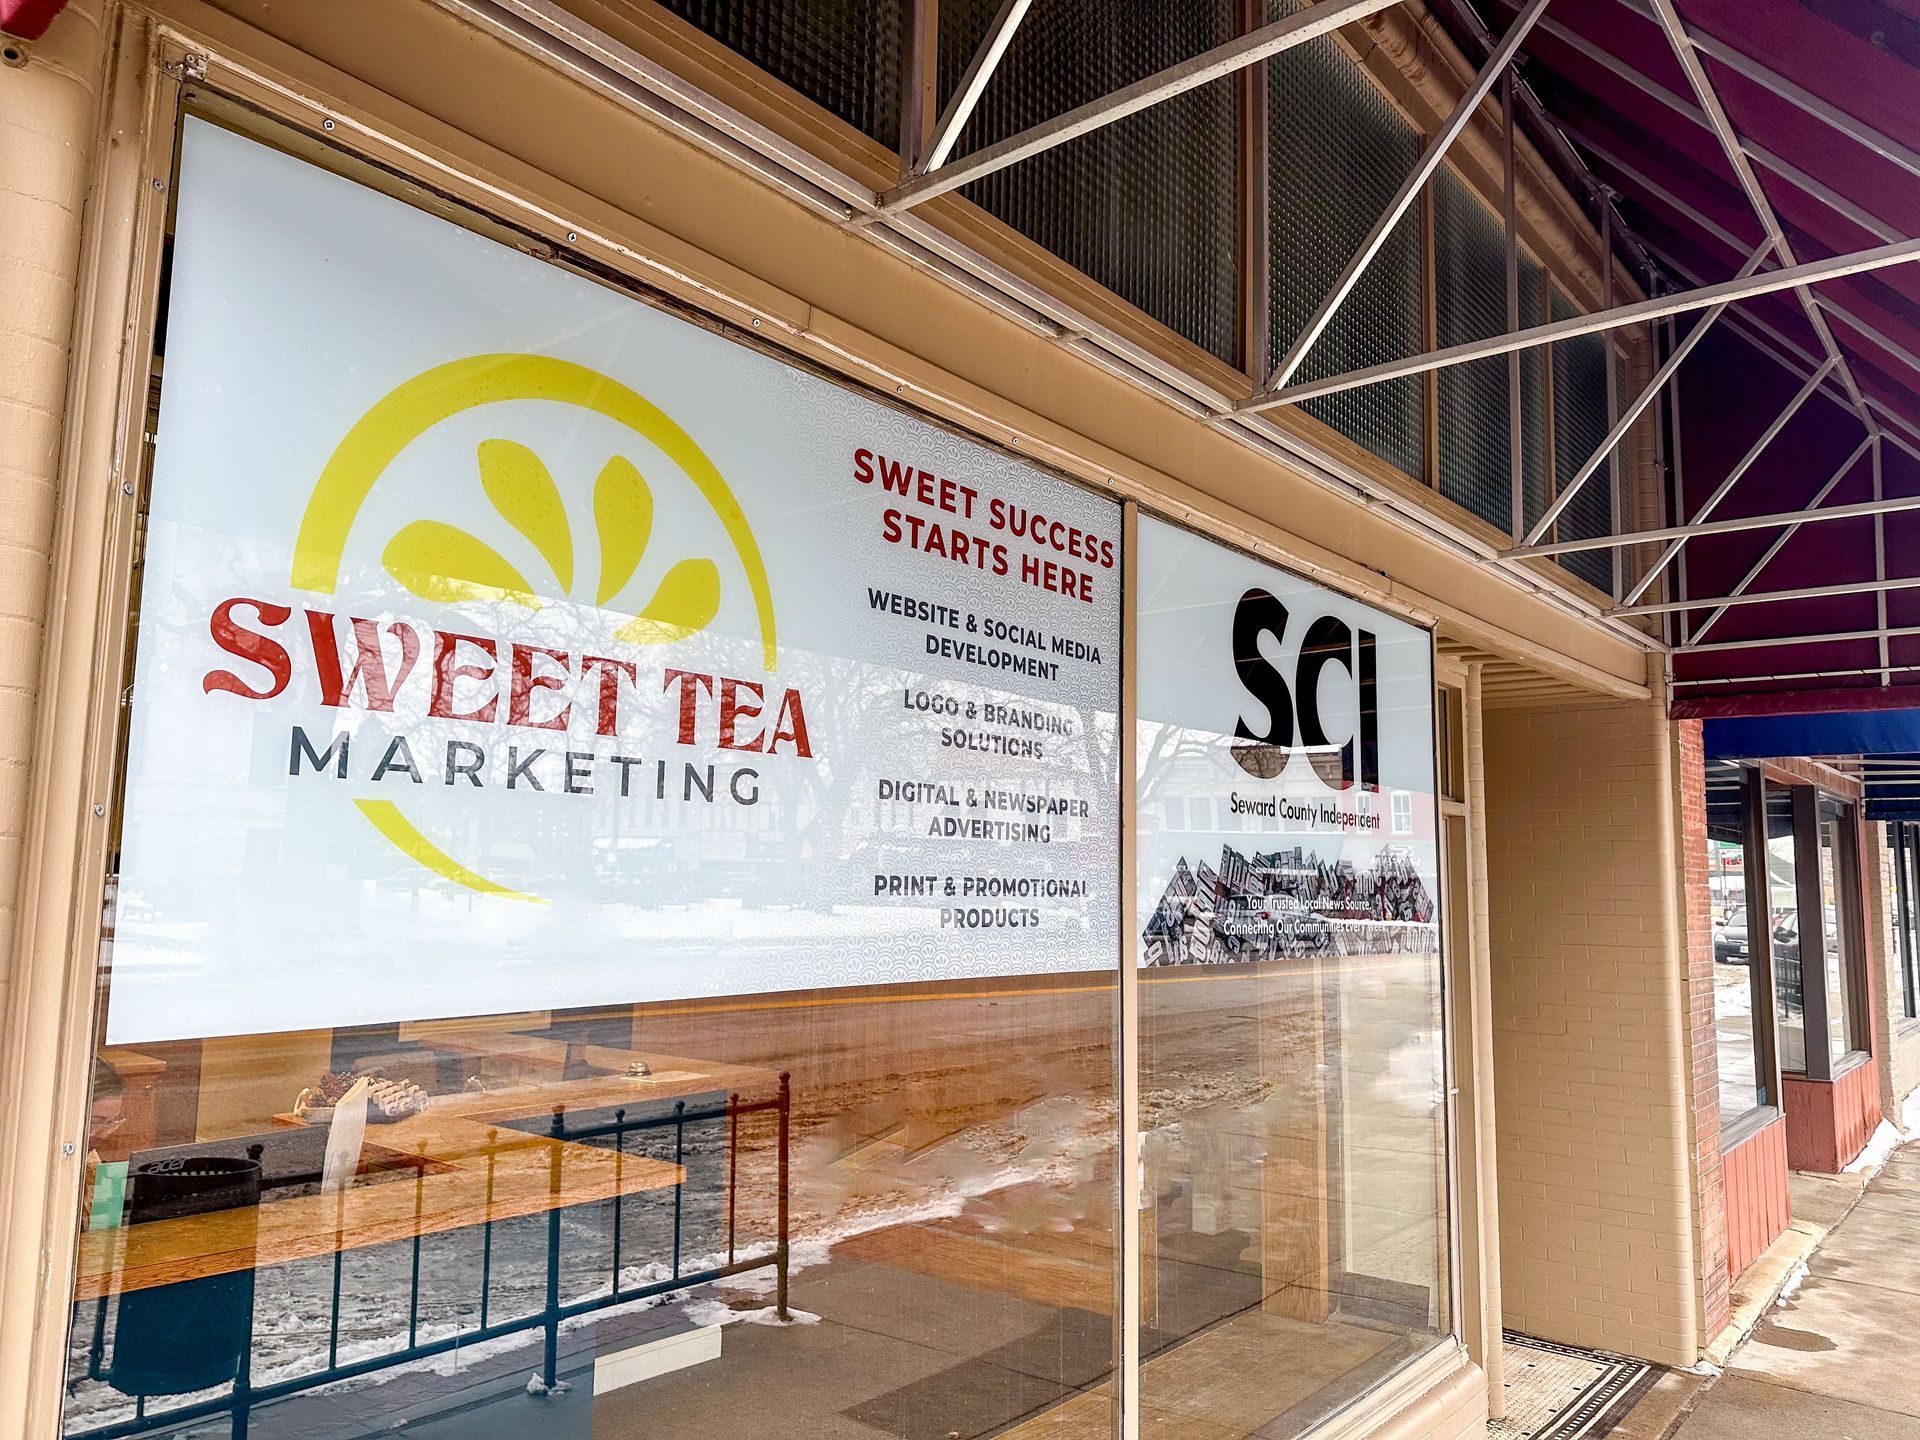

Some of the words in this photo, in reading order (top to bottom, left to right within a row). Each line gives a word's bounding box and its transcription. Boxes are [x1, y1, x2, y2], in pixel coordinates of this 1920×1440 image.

[853, 448, 978, 519] SWEET
[989, 498, 1114, 569] SUCCESS
[882, 508, 1009, 576] STARTS
[1021, 553, 1094, 604] HERE
[867, 587, 959, 629] WEBSITE
[965, 613, 978, 633] &
[984, 618, 1047, 651] SOCIAL
[1051, 635, 1101, 665] MEDIA
[202, 596, 638, 738] SWEET
[663, 667, 813, 758] TEA
[925, 634, 1059, 682] DEVELOPMENT
[903, 688, 959, 716] LOGO
[965, 700, 978, 720] &
[984, 703, 1073, 736] BRANDING
[941, 726, 1043, 760] SOLUTIONS
[288, 725, 760, 806] MARKETING
[878, 778, 960, 806] DIGITAL
[965, 788, 978, 808] &
[984, 789, 1089, 818] NEWSPAPER
[1230, 791, 1276, 818] Seward
[1279, 797, 1318, 829] County
[1320, 803, 1380, 830] Independent
[928, 816, 1051, 843] ADVERTISING
[874, 875, 937, 896] PRINT
[943, 876, 956, 897] &
[963, 876, 1088, 898] PROMOTIONAL
[1246, 894, 1266, 911] Your
[1268, 894, 1299, 911] Trusted
[1300, 895, 1321, 911] Local
[1322, 895, 1344, 911] News
[1345, 896, 1372, 911] Source.
[940, 908, 1040, 929] PRODUCTS
[1223, 919, 1274, 938] Connecting
[1276, 919, 1294, 936] Our
[147, 1157, 187, 1174] acer
